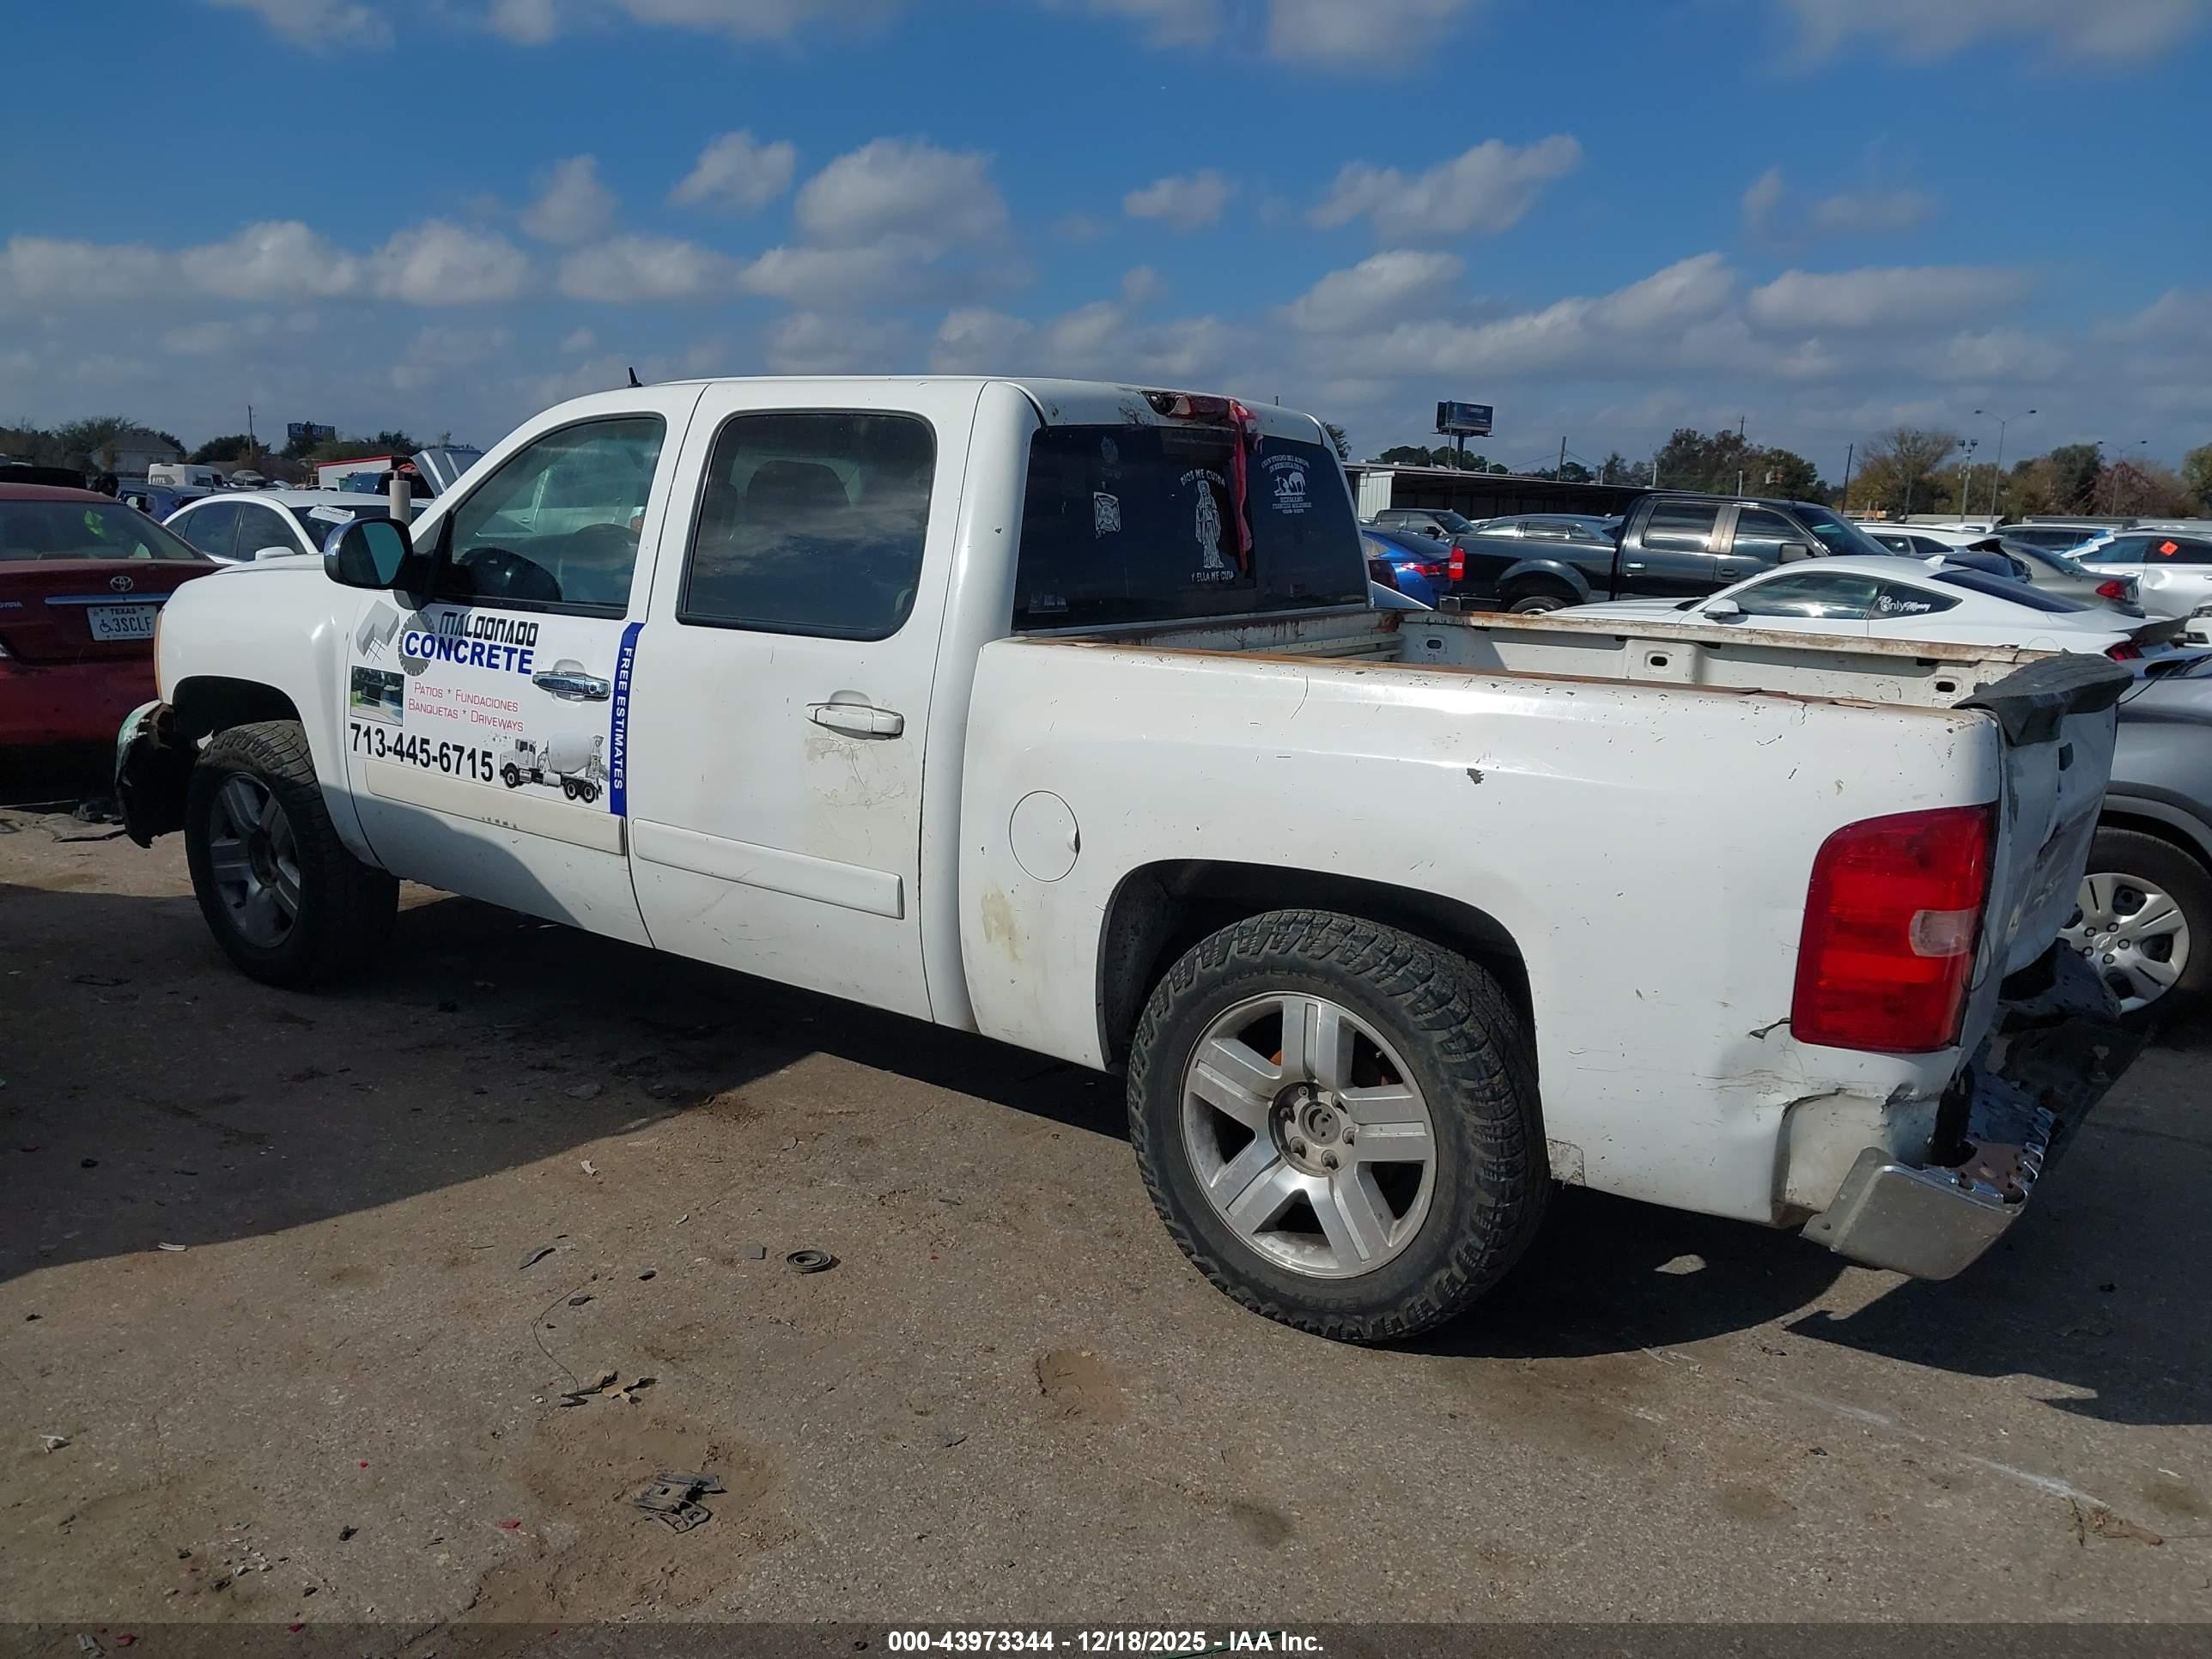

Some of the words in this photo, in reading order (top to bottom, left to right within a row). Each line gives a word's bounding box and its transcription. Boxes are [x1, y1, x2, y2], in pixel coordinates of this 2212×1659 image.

[1194, 468, 1205, 479] ME
[439, 611, 539, 647] MALDONADO
[404, 631, 535, 675] CONCRETE
[618, 647, 633, 691] FREE
[349, 722, 494, 782] 713-445-6715
[613, 696, 627, 790] ESTIMATES
